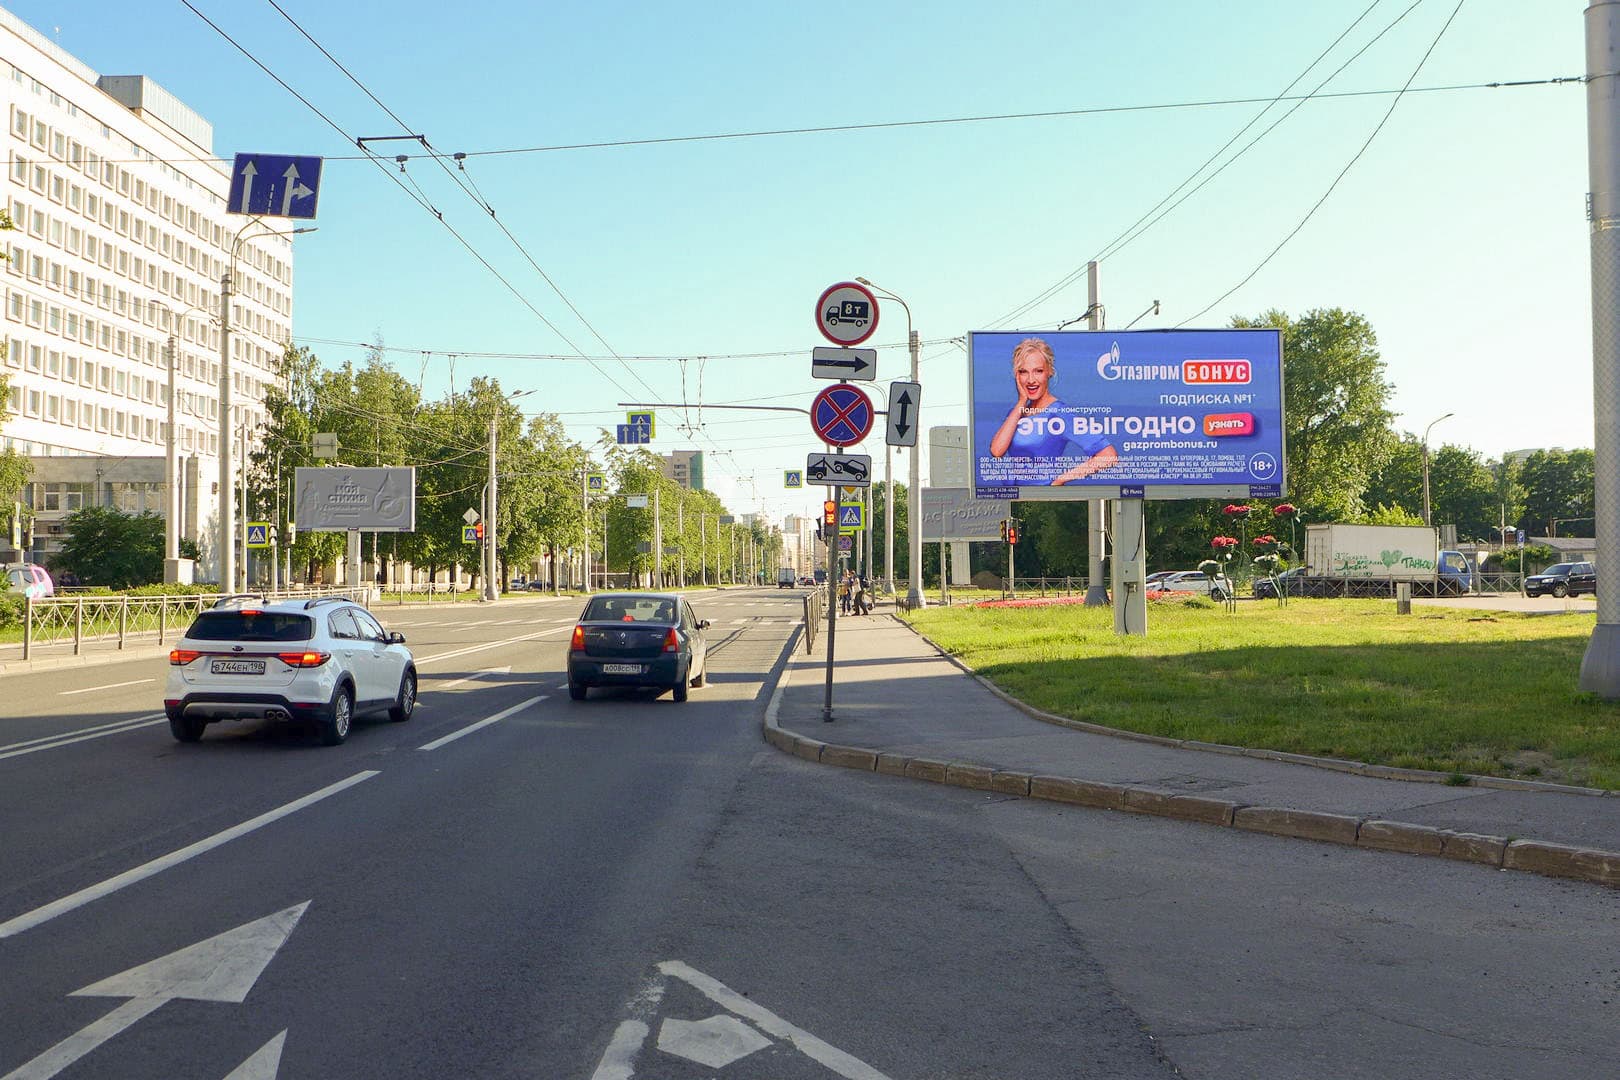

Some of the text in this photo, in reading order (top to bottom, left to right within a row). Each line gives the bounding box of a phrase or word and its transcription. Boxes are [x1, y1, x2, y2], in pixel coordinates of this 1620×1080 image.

[1121, 365, 1247, 381] ГАЗПРОМ БОНУС
[1160, 394, 1231, 407] ПОДПИСКА
[1018, 406, 1112, 415] Подписка-конструктор
[1017, 416, 1196, 438] ЭТО ВЫГОДНО
[1208, 418, 1245, 431] узнать
[1123, 440, 1218, 452] gazprombonus.ru
[1253, 461, 1272, 470] 18+
